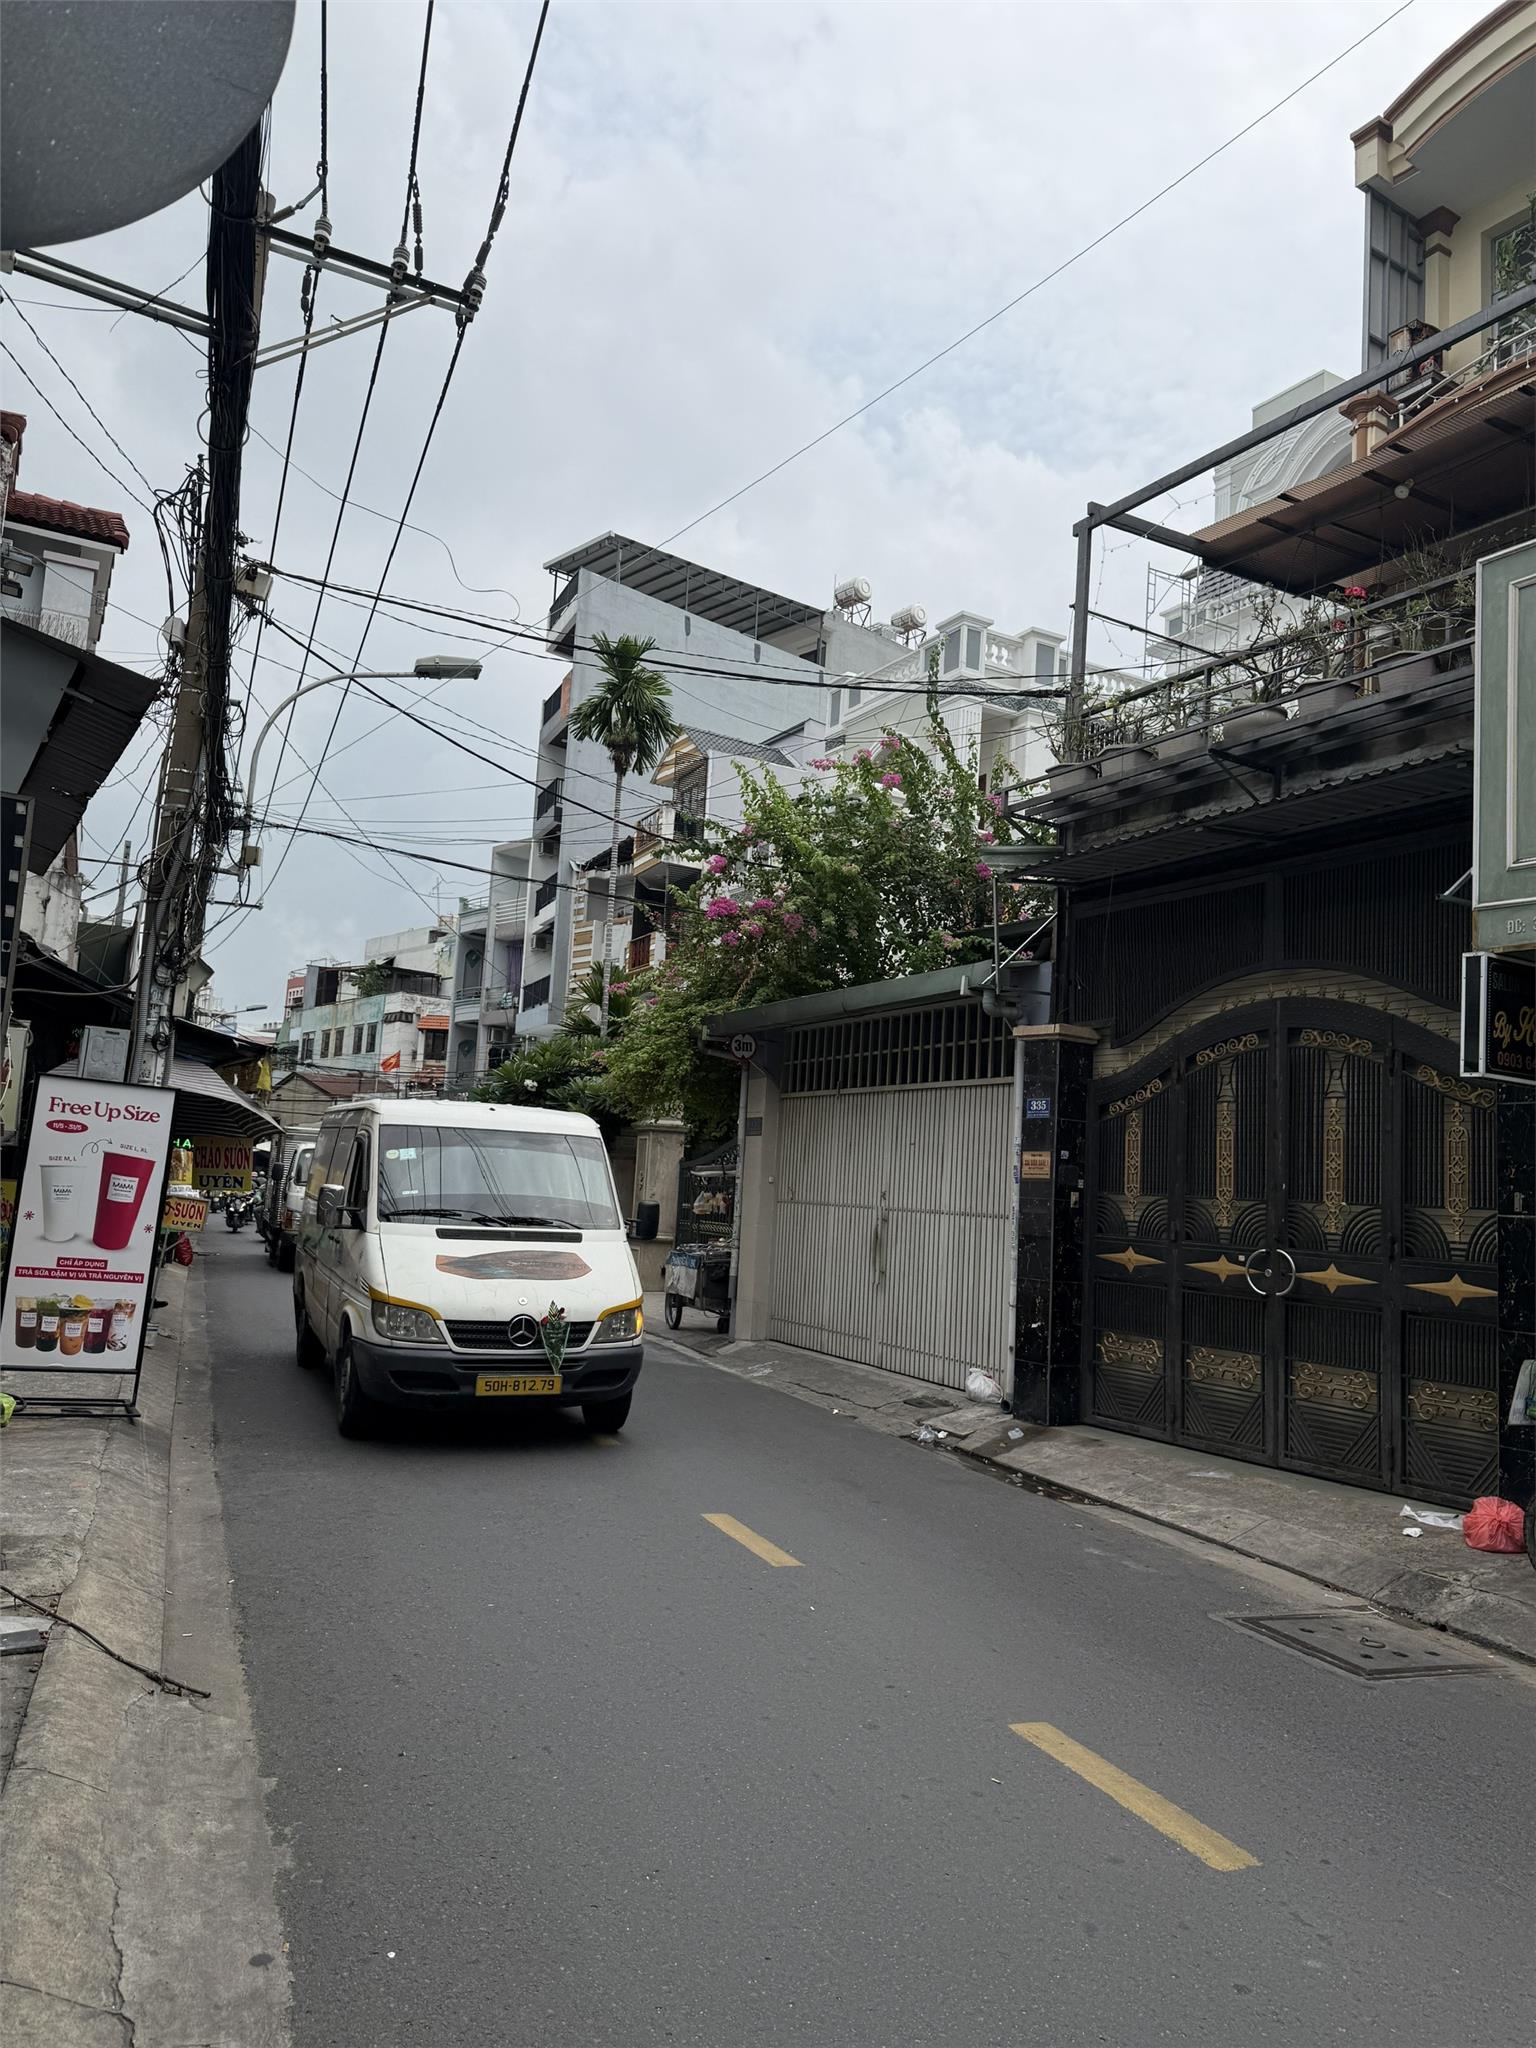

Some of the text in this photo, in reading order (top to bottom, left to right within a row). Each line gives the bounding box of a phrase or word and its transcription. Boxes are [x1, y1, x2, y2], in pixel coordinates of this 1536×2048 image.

[1493, 1011, 1512, 1049] By
[735, 1040, 752, 1053] 3m
[1497, 1051, 1523, 1068] 0903
[48, 1096, 161, 1123] Free Up Size
[1030, 1100, 1046, 1111] 335
[120, 1143, 135, 1151] SIZE
[199, 1173, 245, 1189] UYÊN
[84, 1260, 105, 1268] DỤNG
[484, 1380, 555, 1392] 50H-812.79
